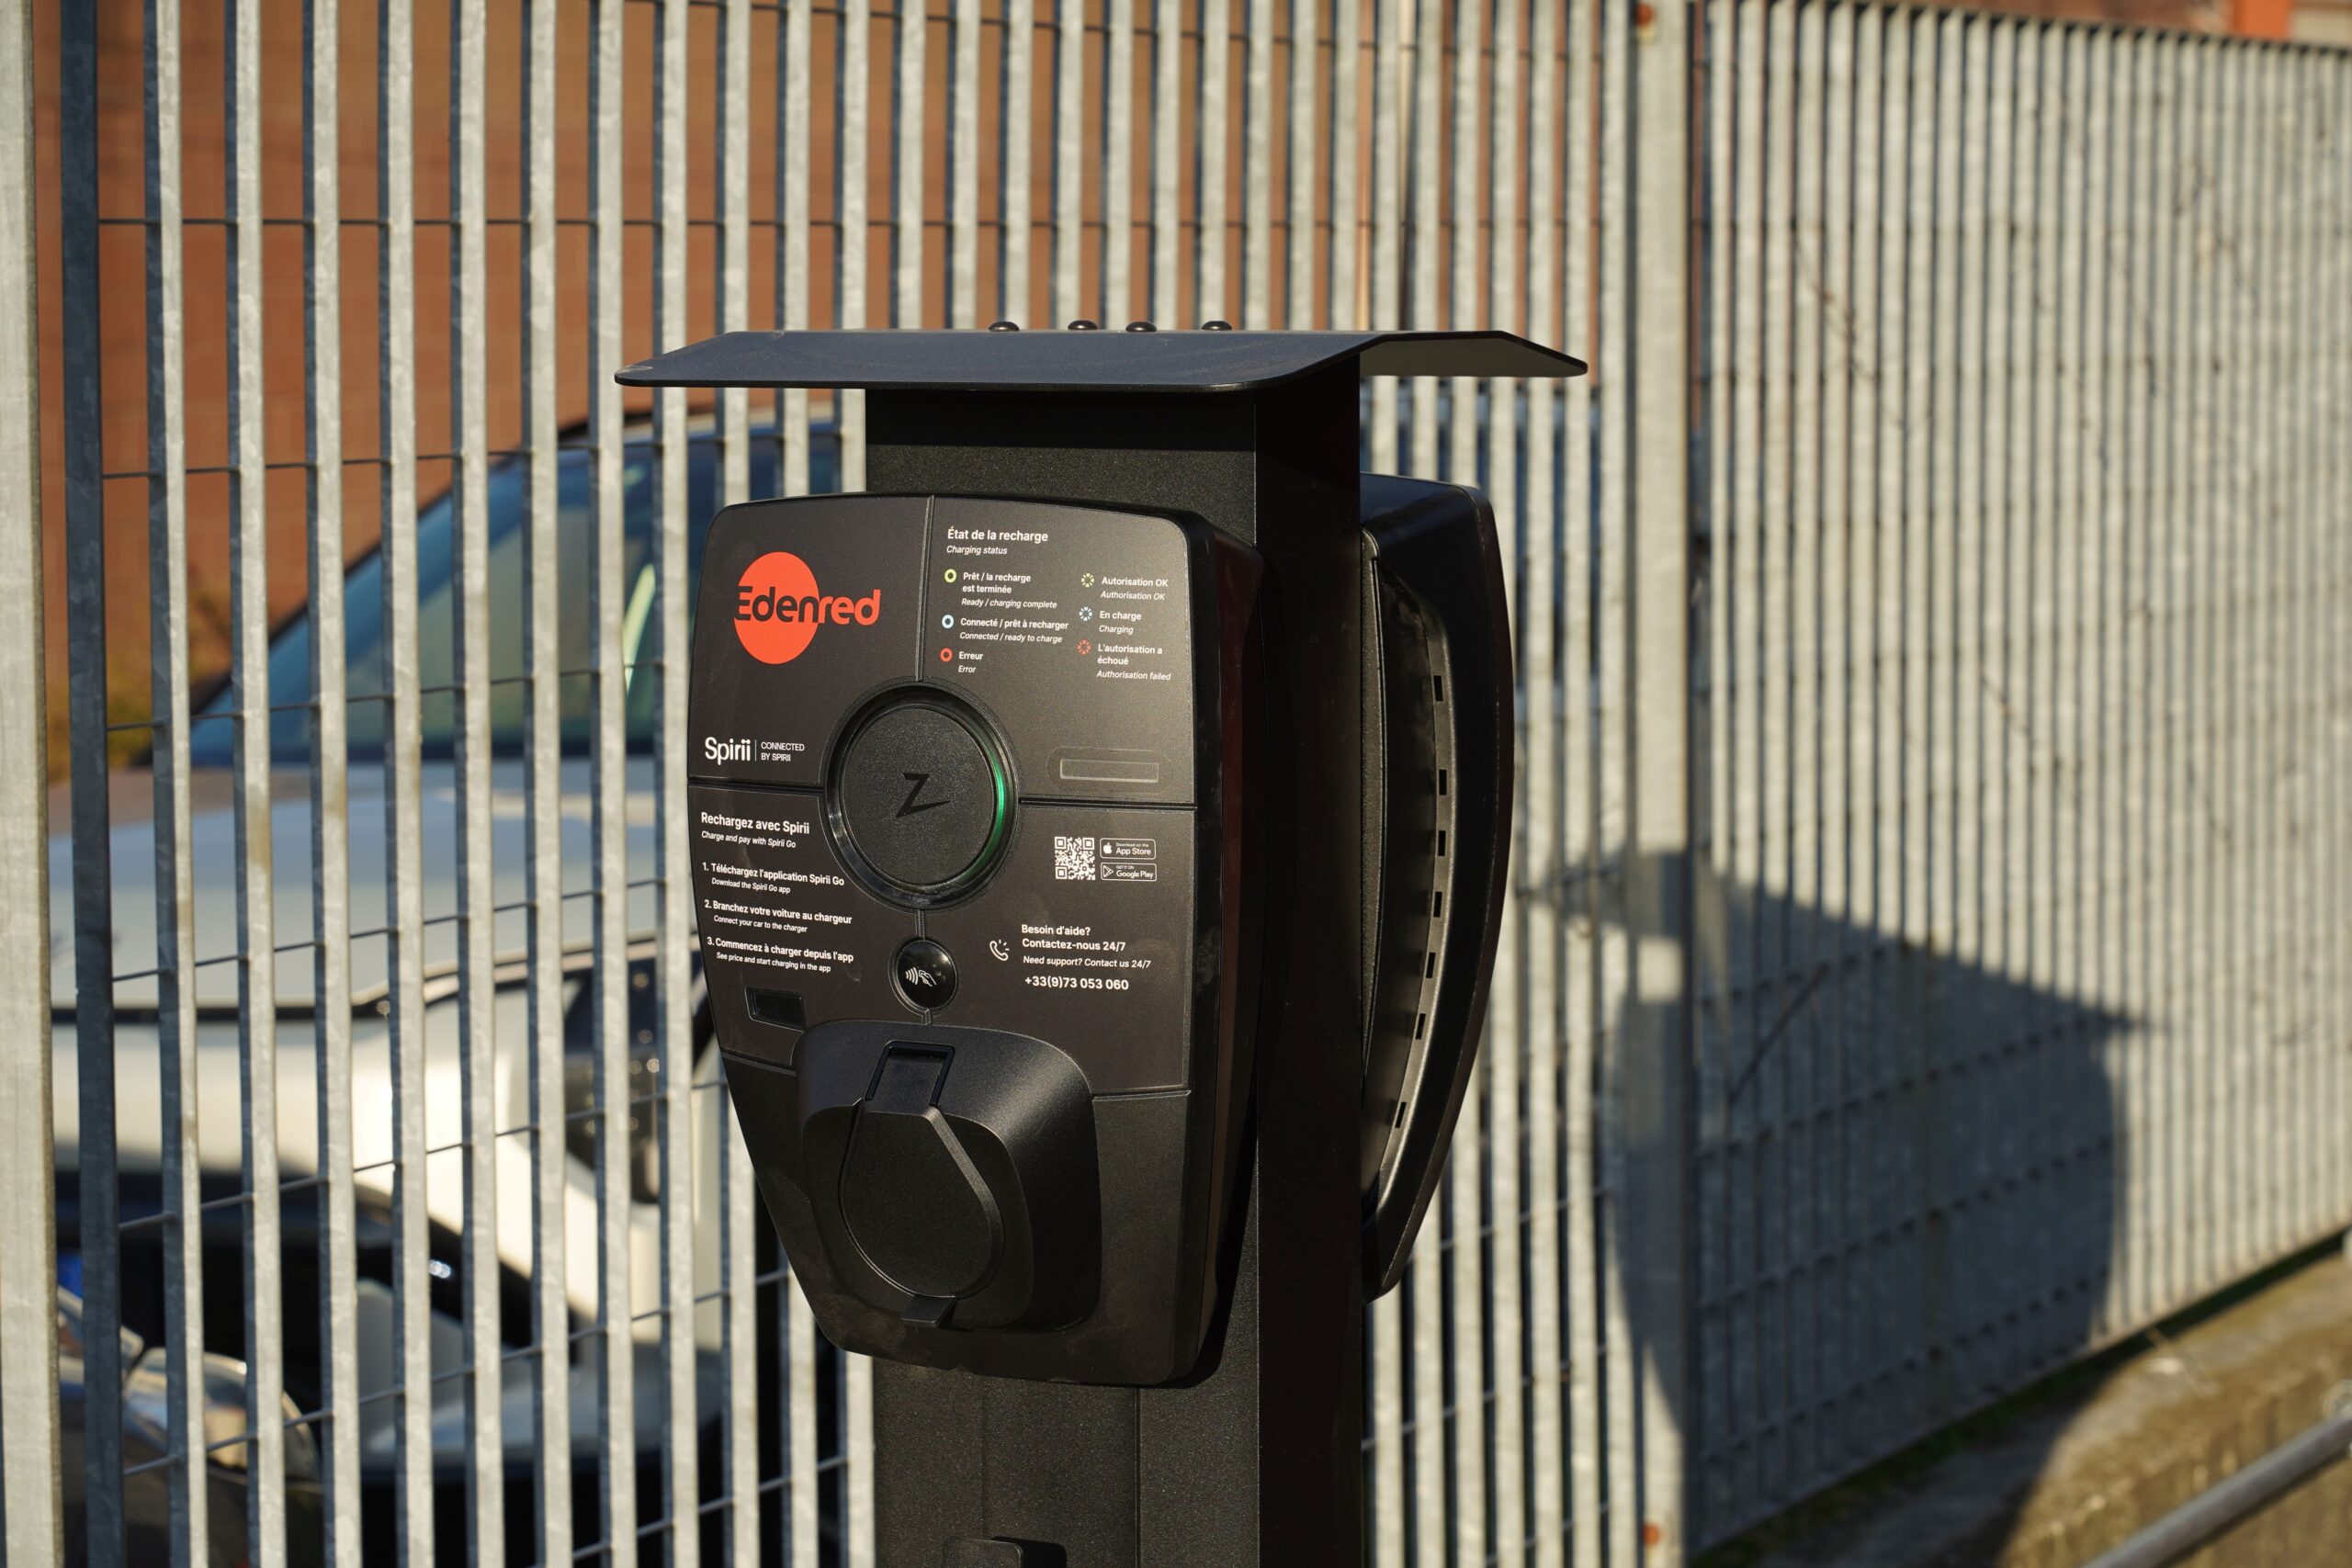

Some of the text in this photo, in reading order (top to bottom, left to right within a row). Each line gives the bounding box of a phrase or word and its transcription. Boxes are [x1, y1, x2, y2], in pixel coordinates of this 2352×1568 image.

[948, 526, 1048, 543] État de la recharge
[947, 545, 1007, 555] Charging status
[963, 572, 979, 581] Prêt
[986, 573, 993, 581] la
[995, 573, 1031, 583] recharge
[1102, 577, 1168, 587] Autorisation OK
[976, 584, 1011, 594] terminée
[1101, 591, 1152, 600] Authorisation
[735, 586, 881, 626] Edenred
[962, 598, 984, 608] Ready
[990, 600, 1021, 608] charging
[1023, 600, 1057, 609] complete
[1100, 611, 1141, 622] En charge
[960, 618, 998, 627] Connecté
[1005, 619, 1021, 629] prêt
[1023, 619, 1028, 628] à
[1030, 620, 1069, 630] recharger
[1099, 625, 1134, 634] Charging
[1036, 635, 1062, 644] charge
[959, 652, 983, 660] Erreur
[1098, 657, 1129, 665] échoué
[1097, 670, 1171, 680] Authorisation failed
[705, 737, 750, 765] Spirii
[761, 742, 805, 751] CONNECTED
[701, 812, 809, 835] Rechargez avec Spirii
[702, 831, 724, 842] Charge
[726, 834, 737, 842] and
[738, 836, 751, 844] pay
[768, 838, 785, 847] Spirii
[702, 862, 709, 871] 1.
[711, 863, 758, 878] Téléchargez
[809, 874, 830, 886] Spirii
[832, 877, 844, 886] Go
[1116, 870, 1153, 879] Google Play
[712, 878, 740, 887] Download
[752, 883, 767, 891] Spirii
[704, 899, 712, 908] 2.
[713, 900, 748, 913] Branchez
[750, 906, 770, 916] votre
[772, 909, 800, 919] voiture
[814, 914, 852, 924] chargeur
[714, 915, 738, 925] Connect
[739, 919, 752, 927] your
[783, 924, 807, 933] charger
[1021, 924, 1054, 935] Besoin
[707, 937, 714, 946] 3.
[716, 938, 763, 952] Commencez
[764, 944, 769, 953] à
[771, 946, 801, 957] charger
[804, 949, 831, 961] depuis
[1022, 939, 1126, 951] Contactez-nous 24/7
[716, 952, 727, 960] See
[729, 954, 743, 962] price
[756, 957, 771, 965] start
[771, 959, 798, 970] charging
[1023, 956, 1044, 965] Need
[1046, 958, 1082, 967] support?
[1084, 959, 1117, 967] Contact
[1131, 960, 1151, 969] 24/7
[1025, 976, 1129, 990] +33(9)73 053 060
